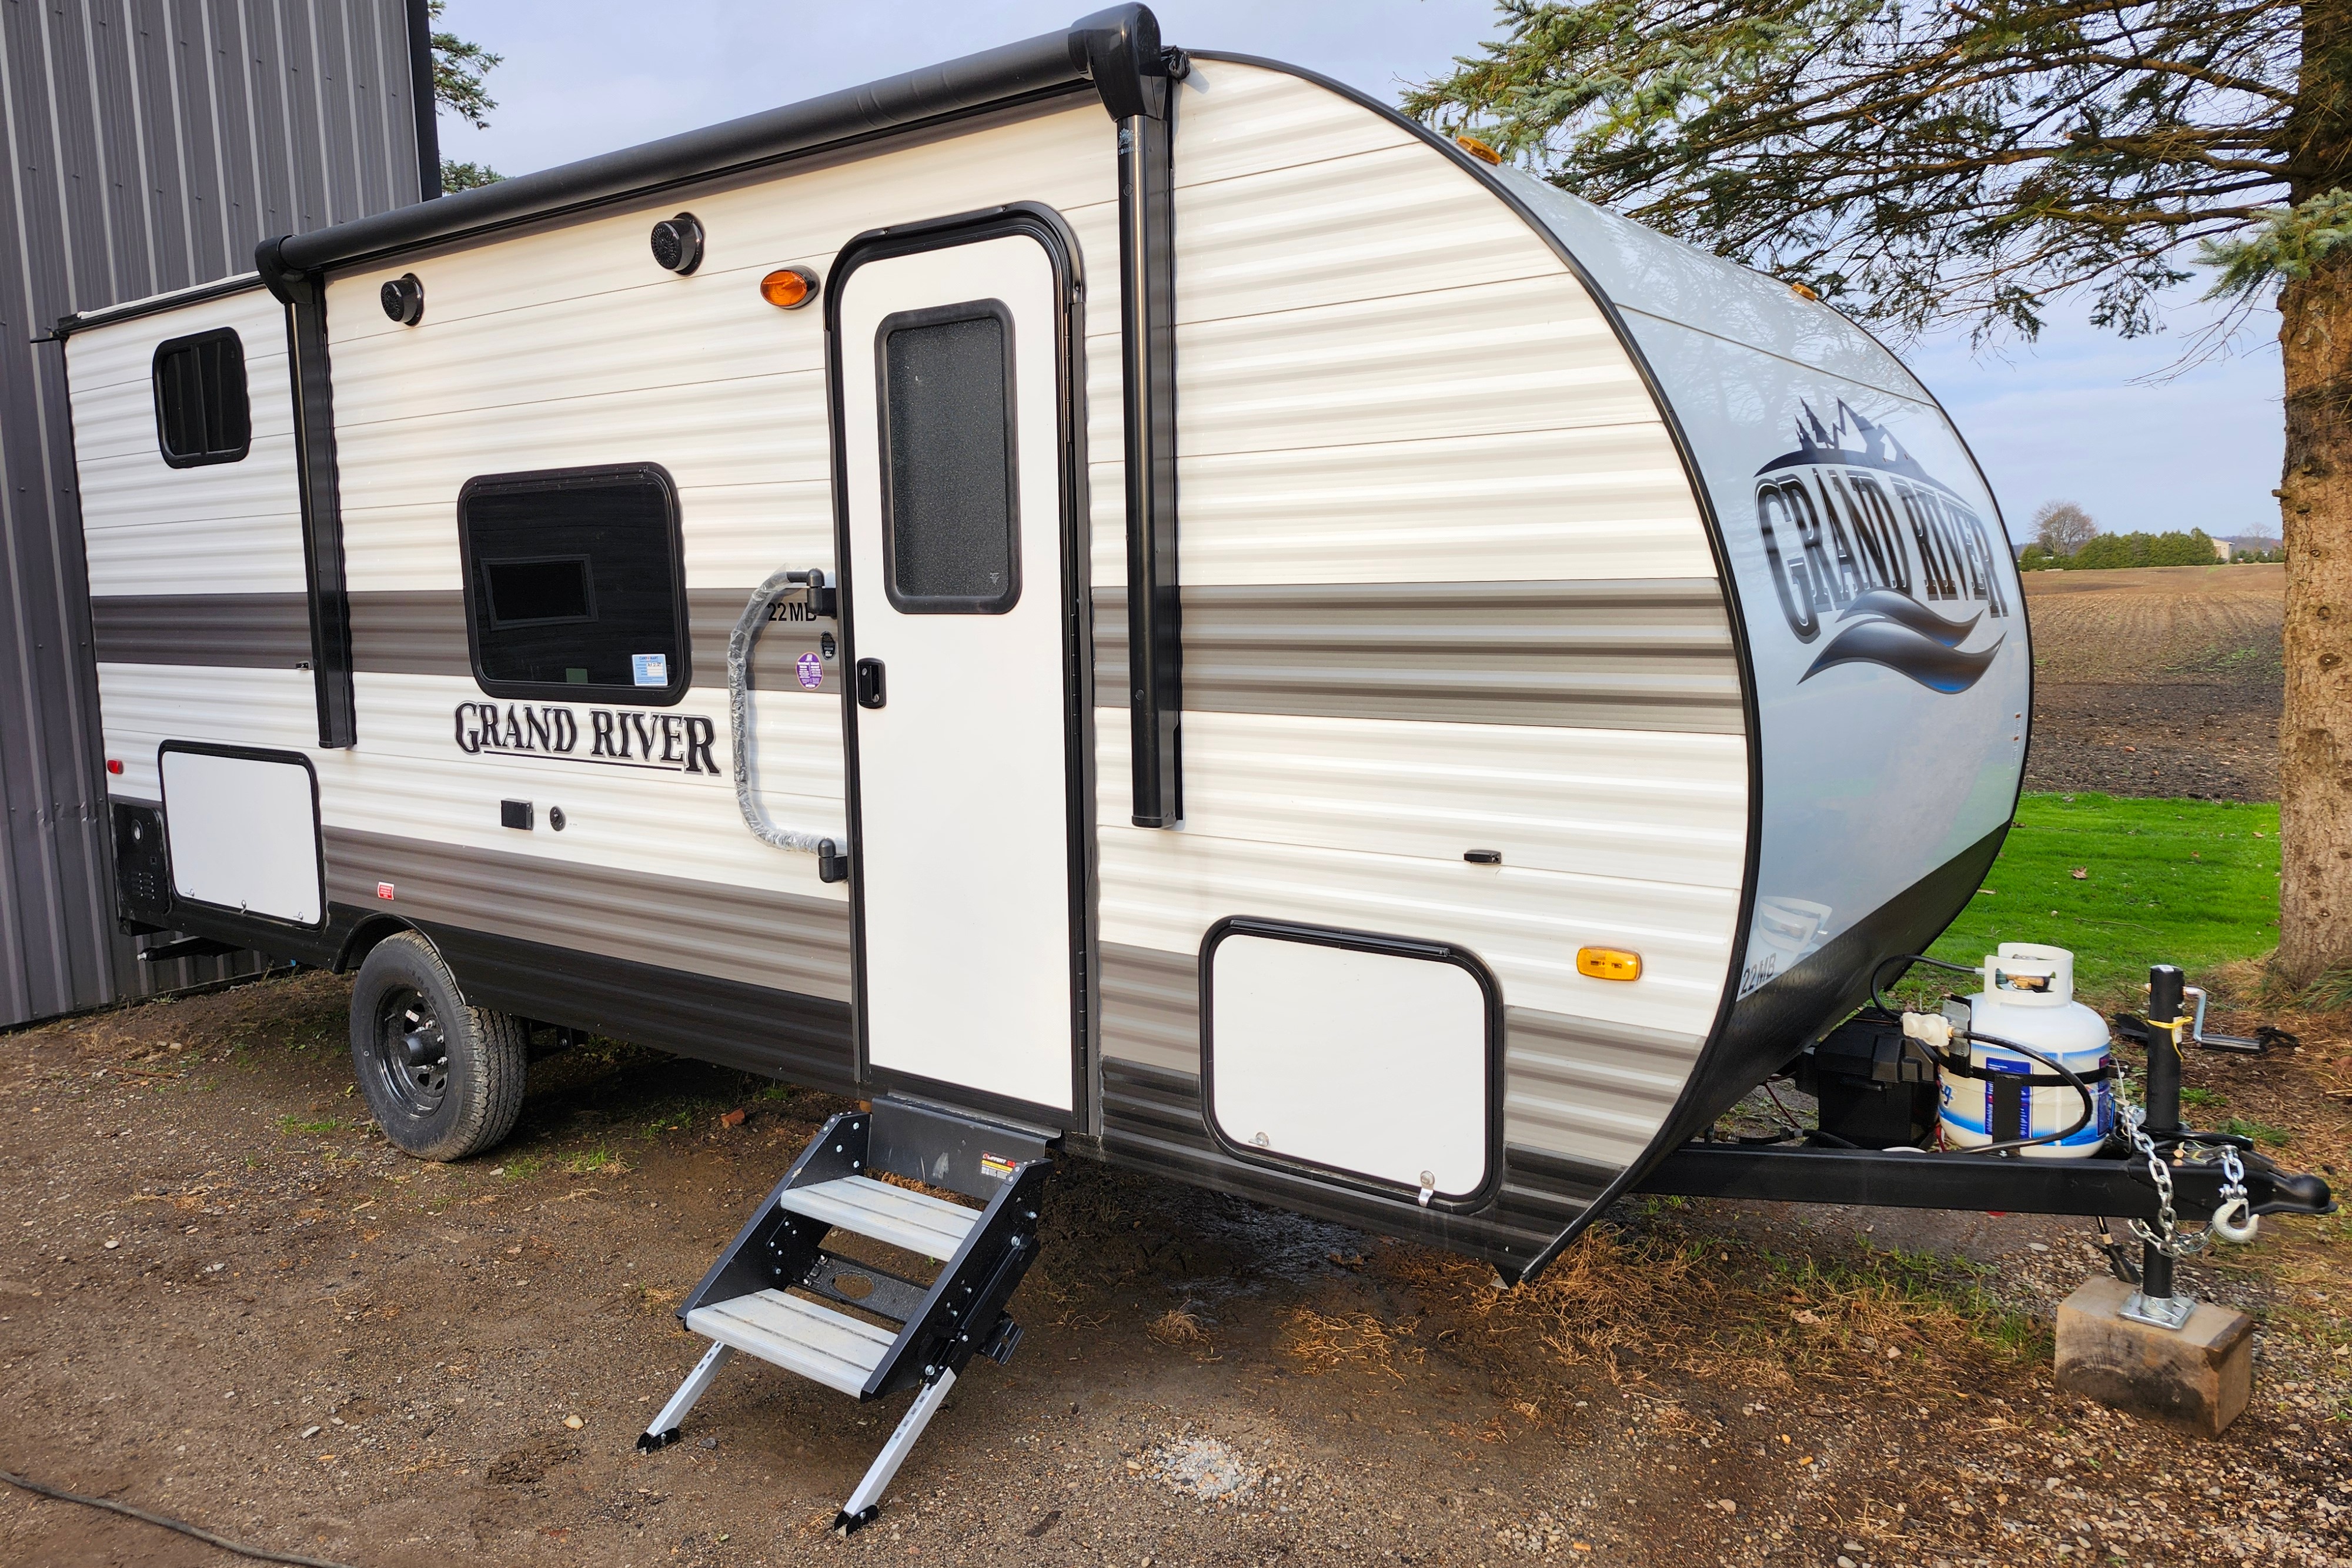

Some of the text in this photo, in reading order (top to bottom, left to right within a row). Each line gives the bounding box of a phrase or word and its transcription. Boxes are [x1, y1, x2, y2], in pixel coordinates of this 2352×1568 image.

[1118, 146, 1141, 155] COMPAS
[1755, 468, 2009, 644] GRAND RIVER
[454, 700, 722, 777] GRAND RIVER
[1740, 952, 1776, 995] 22MB
